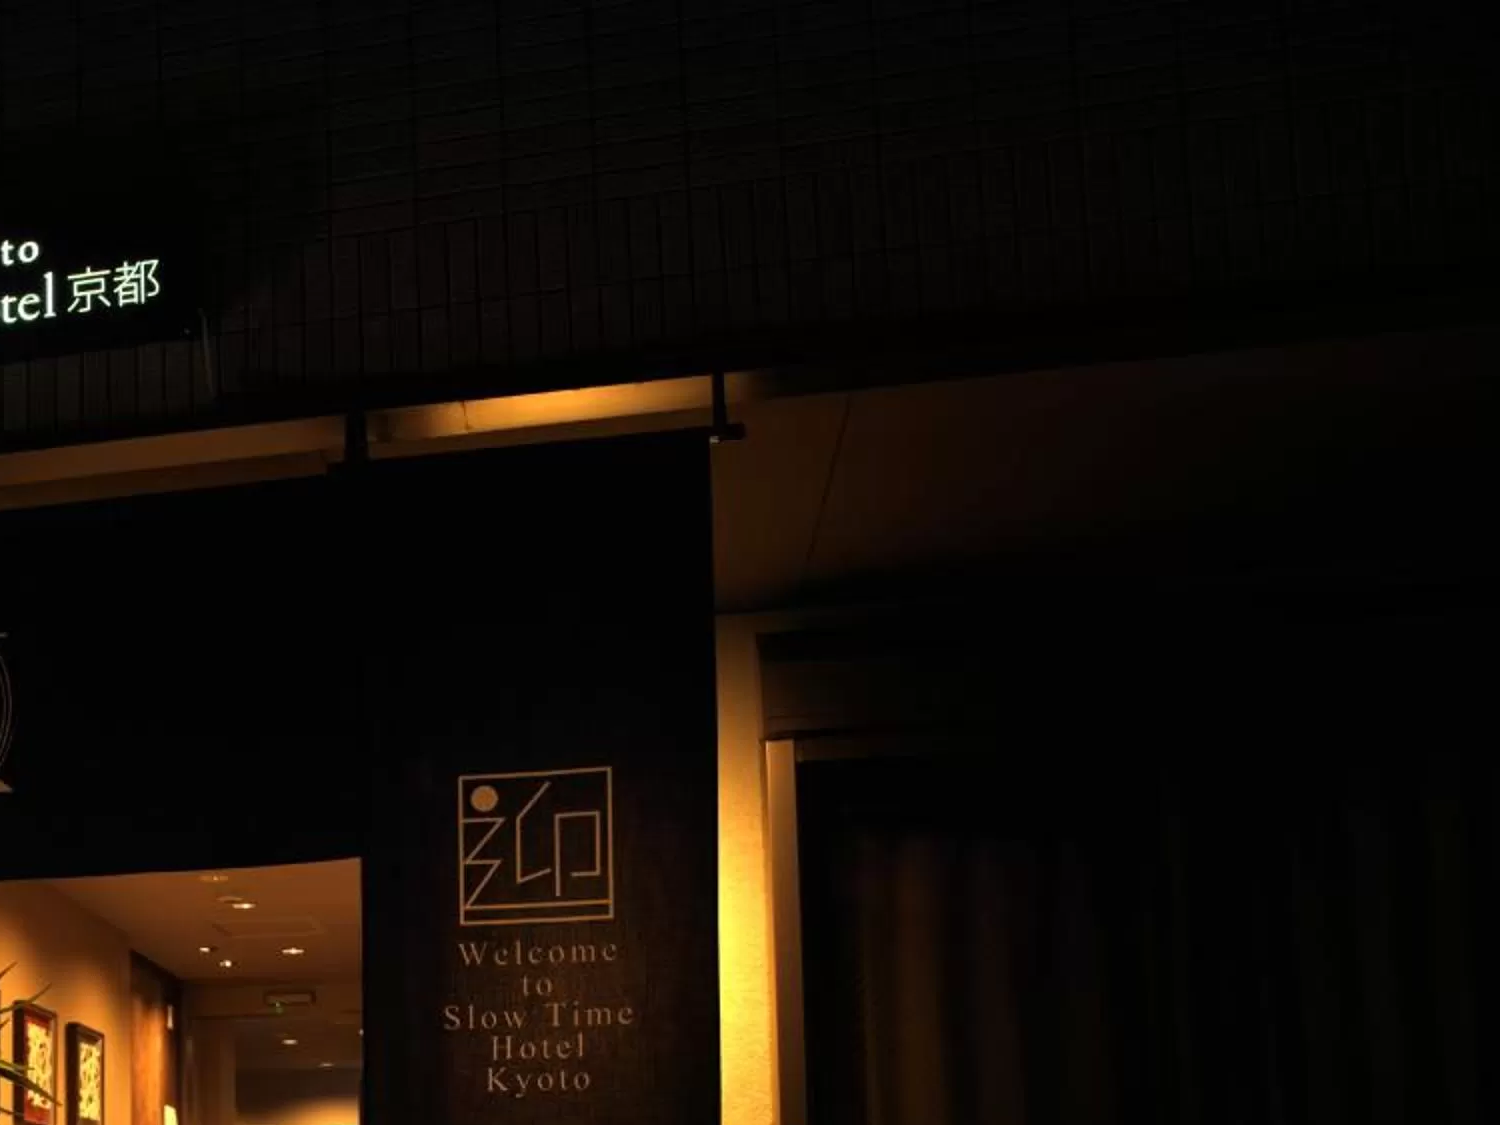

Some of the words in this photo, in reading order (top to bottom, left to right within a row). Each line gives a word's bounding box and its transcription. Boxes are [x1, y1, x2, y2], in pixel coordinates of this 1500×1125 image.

[0, 240, 40, 267] to
[67, 259, 161, 314] 京都
[459, 940, 617, 966] Welcome
[521, 974, 553, 997] to
[444, 1004, 526, 1030] Slow
[544, 1000, 633, 1028] Time
[491, 1032, 583, 1061] Hotel
[487, 1067, 591, 1098] Kyoto
